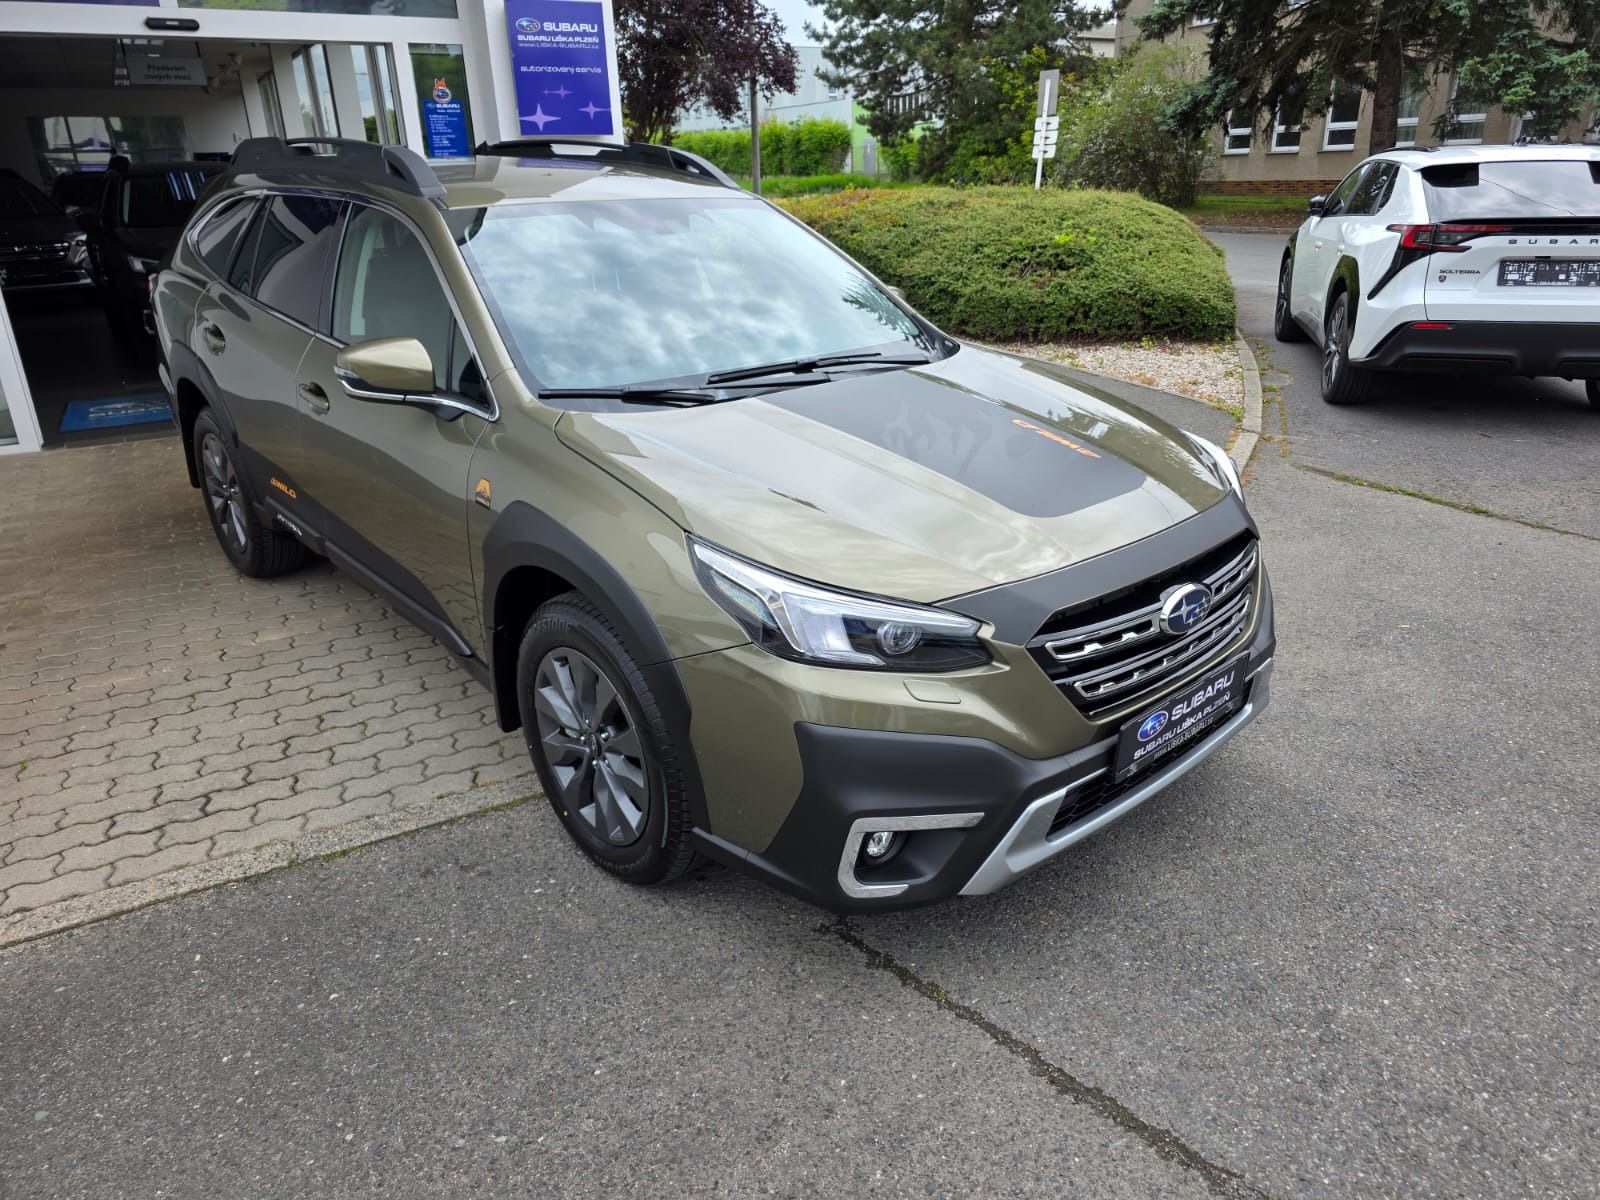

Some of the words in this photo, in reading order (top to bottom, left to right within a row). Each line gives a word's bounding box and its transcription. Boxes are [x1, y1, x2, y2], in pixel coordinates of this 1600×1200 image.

[543, 22, 598, 32] SUBARU
[1171, 670, 1235, 721] SUBARU
[1133, 727, 1177, 760] SUBARU
